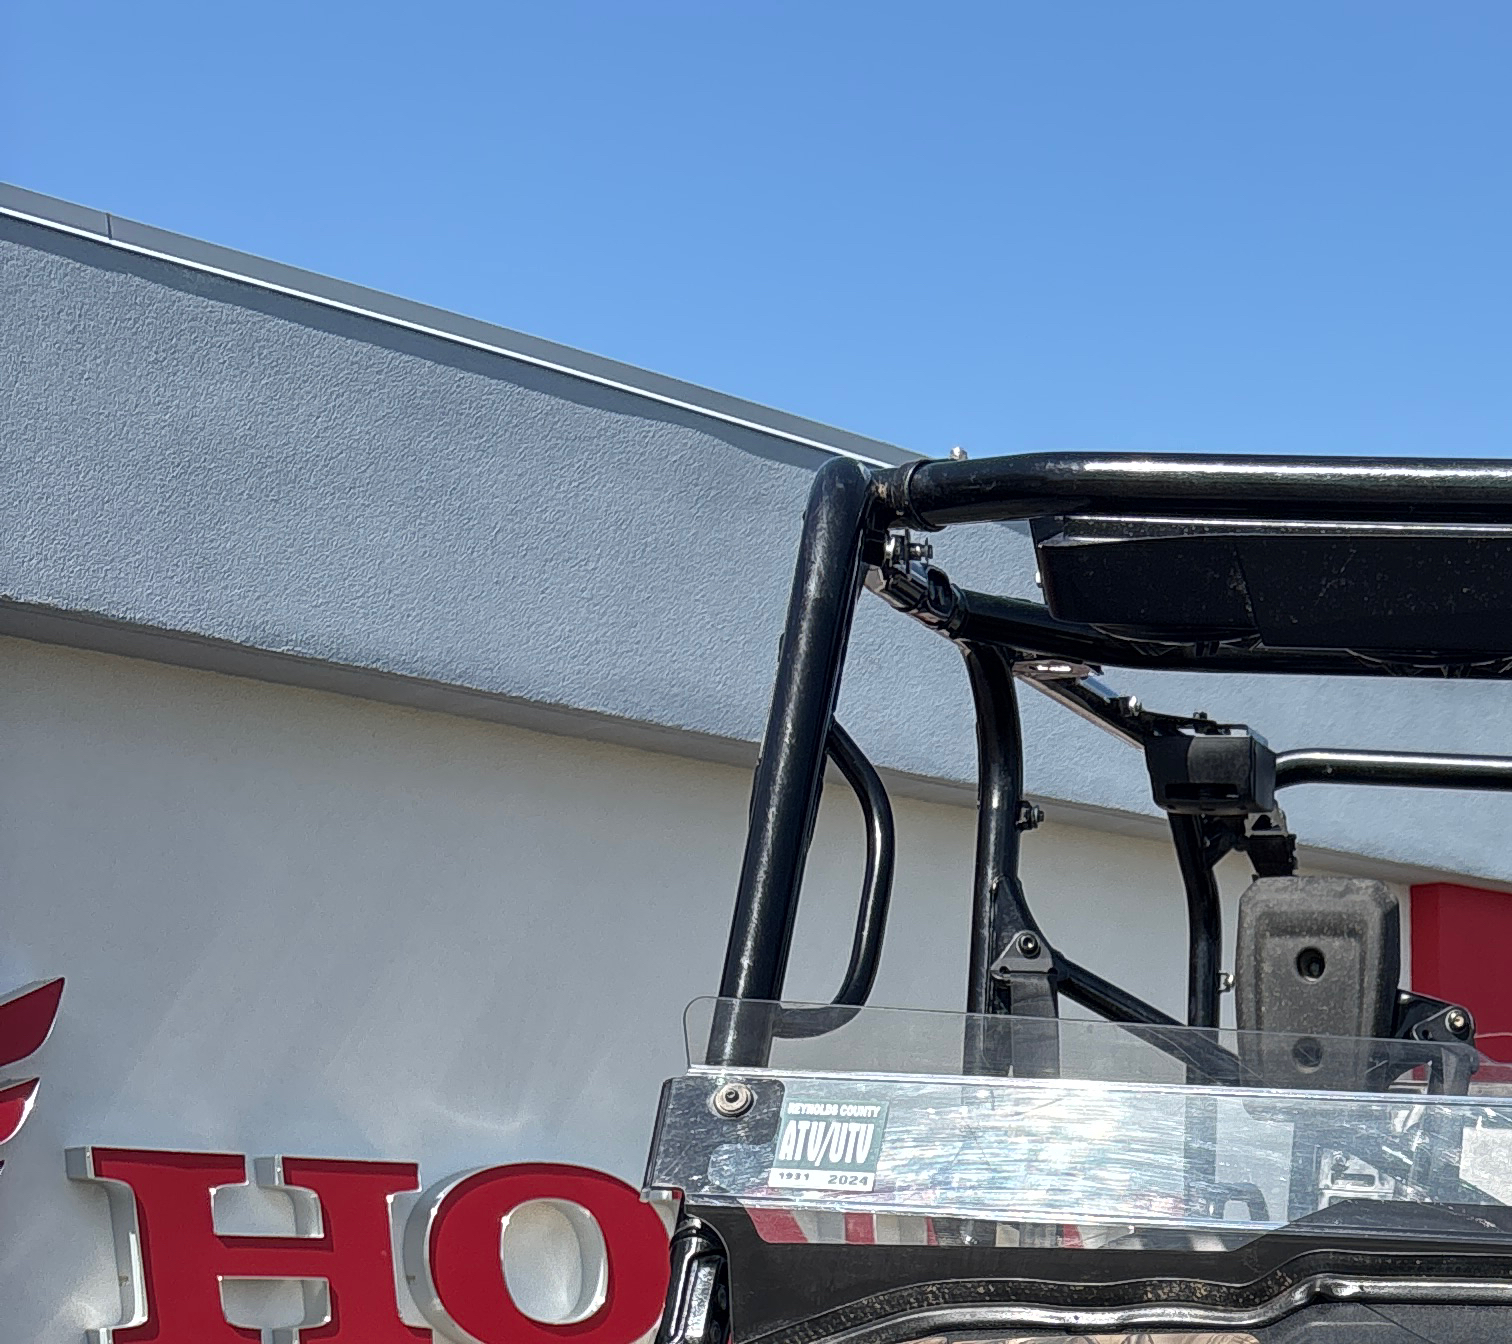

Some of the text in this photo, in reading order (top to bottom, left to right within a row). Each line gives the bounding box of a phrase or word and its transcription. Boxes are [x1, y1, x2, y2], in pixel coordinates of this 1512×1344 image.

[839, 1104, 881, 1117] COUNTY
[778, 1120, 875, 1167] ATV/UTV
[828, 1174, 869, 1186] 2024
